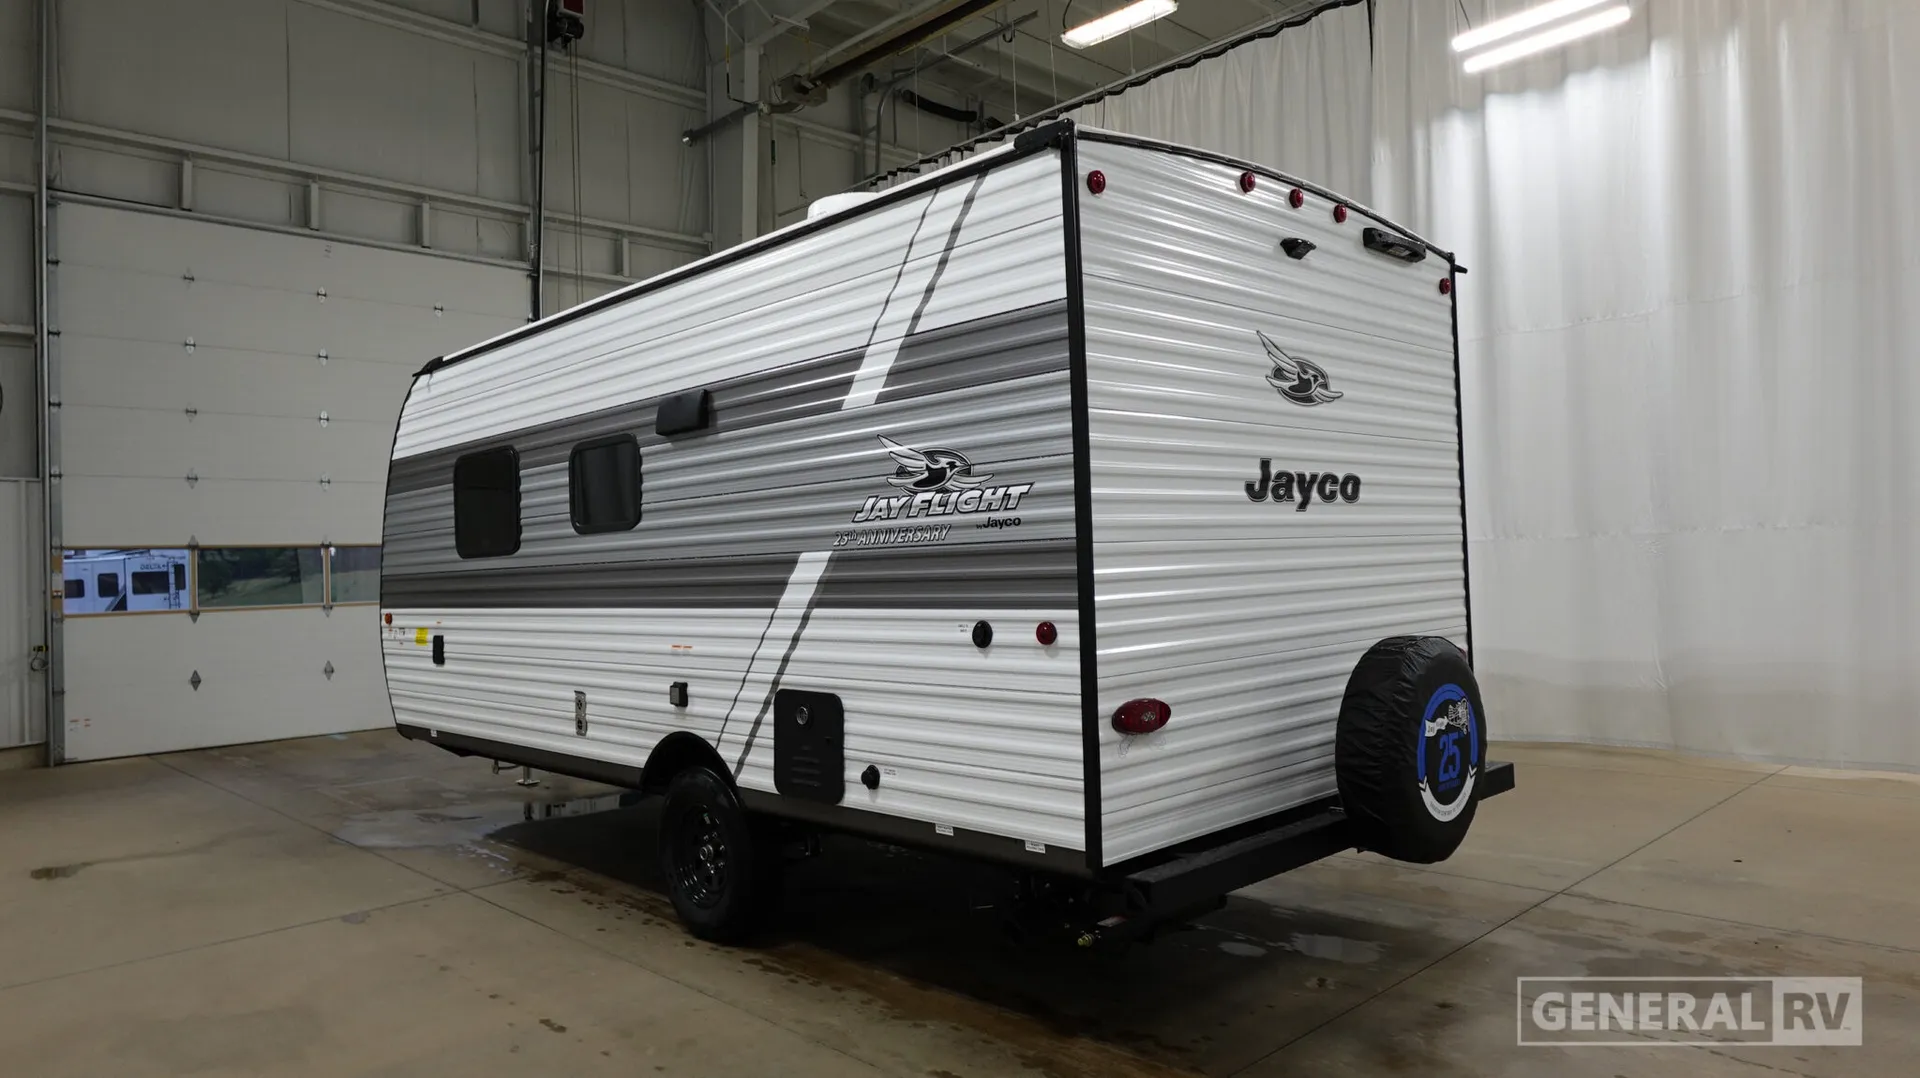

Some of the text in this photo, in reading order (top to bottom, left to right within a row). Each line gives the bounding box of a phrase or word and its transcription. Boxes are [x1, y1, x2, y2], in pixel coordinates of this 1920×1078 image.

[852, 481, 1035, 523] JAY FLIGHT
[1245, 458, 1361, 512] Jayco
[833, 524, 951, 547] 25th ANNIVERSARY
[983, 516, 1021, 530] Jayco
[1439, 731, 1461, 782] 25
